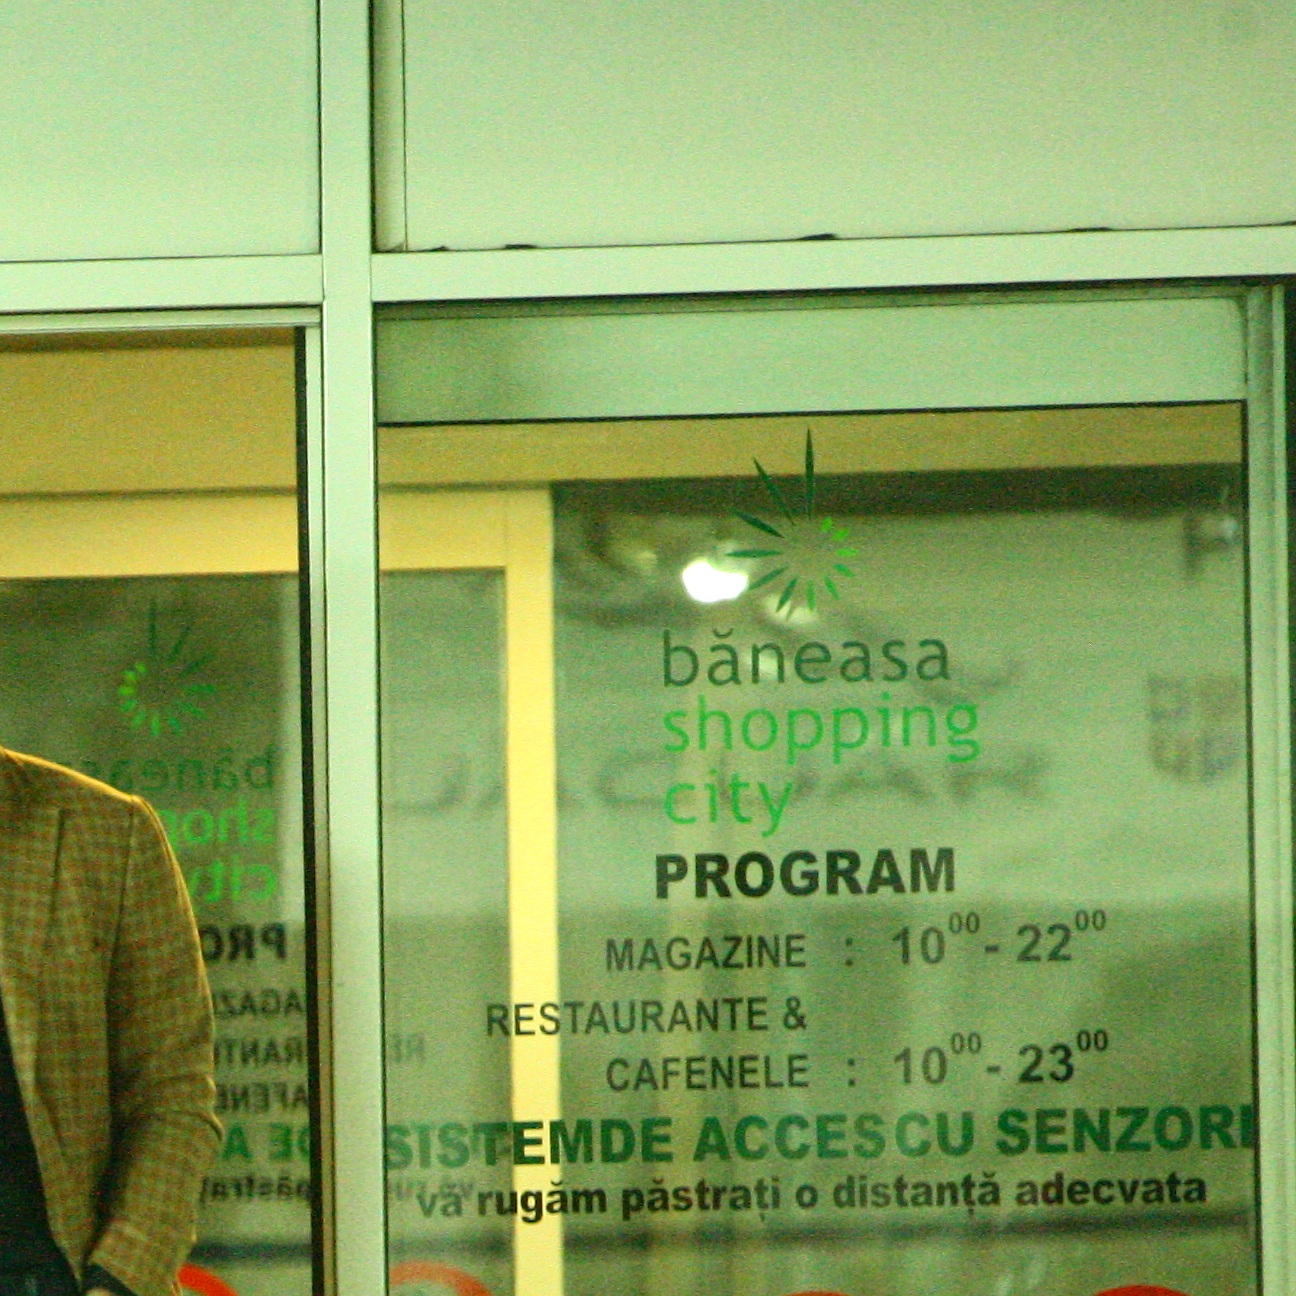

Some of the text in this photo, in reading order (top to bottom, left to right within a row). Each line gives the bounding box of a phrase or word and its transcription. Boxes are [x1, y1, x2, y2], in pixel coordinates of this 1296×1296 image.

[662, 628, 951, 687] băneasa
[663, 692, 981, 764] shopping
[663, 769, 794, 837] city
[655, 847, 956, 898] PROGRAM
[605, 934, 807, 973] MAGAZINE
[486, 996, 807, 1036] RESTAURANTE &
[606, 1053, 809, 1091] CAFENELE
[477, 1179, 607, 1224] rugăm
[794, 1187, 818, 1208] o
[1015, 1172, 1207, 1207] adecvata
